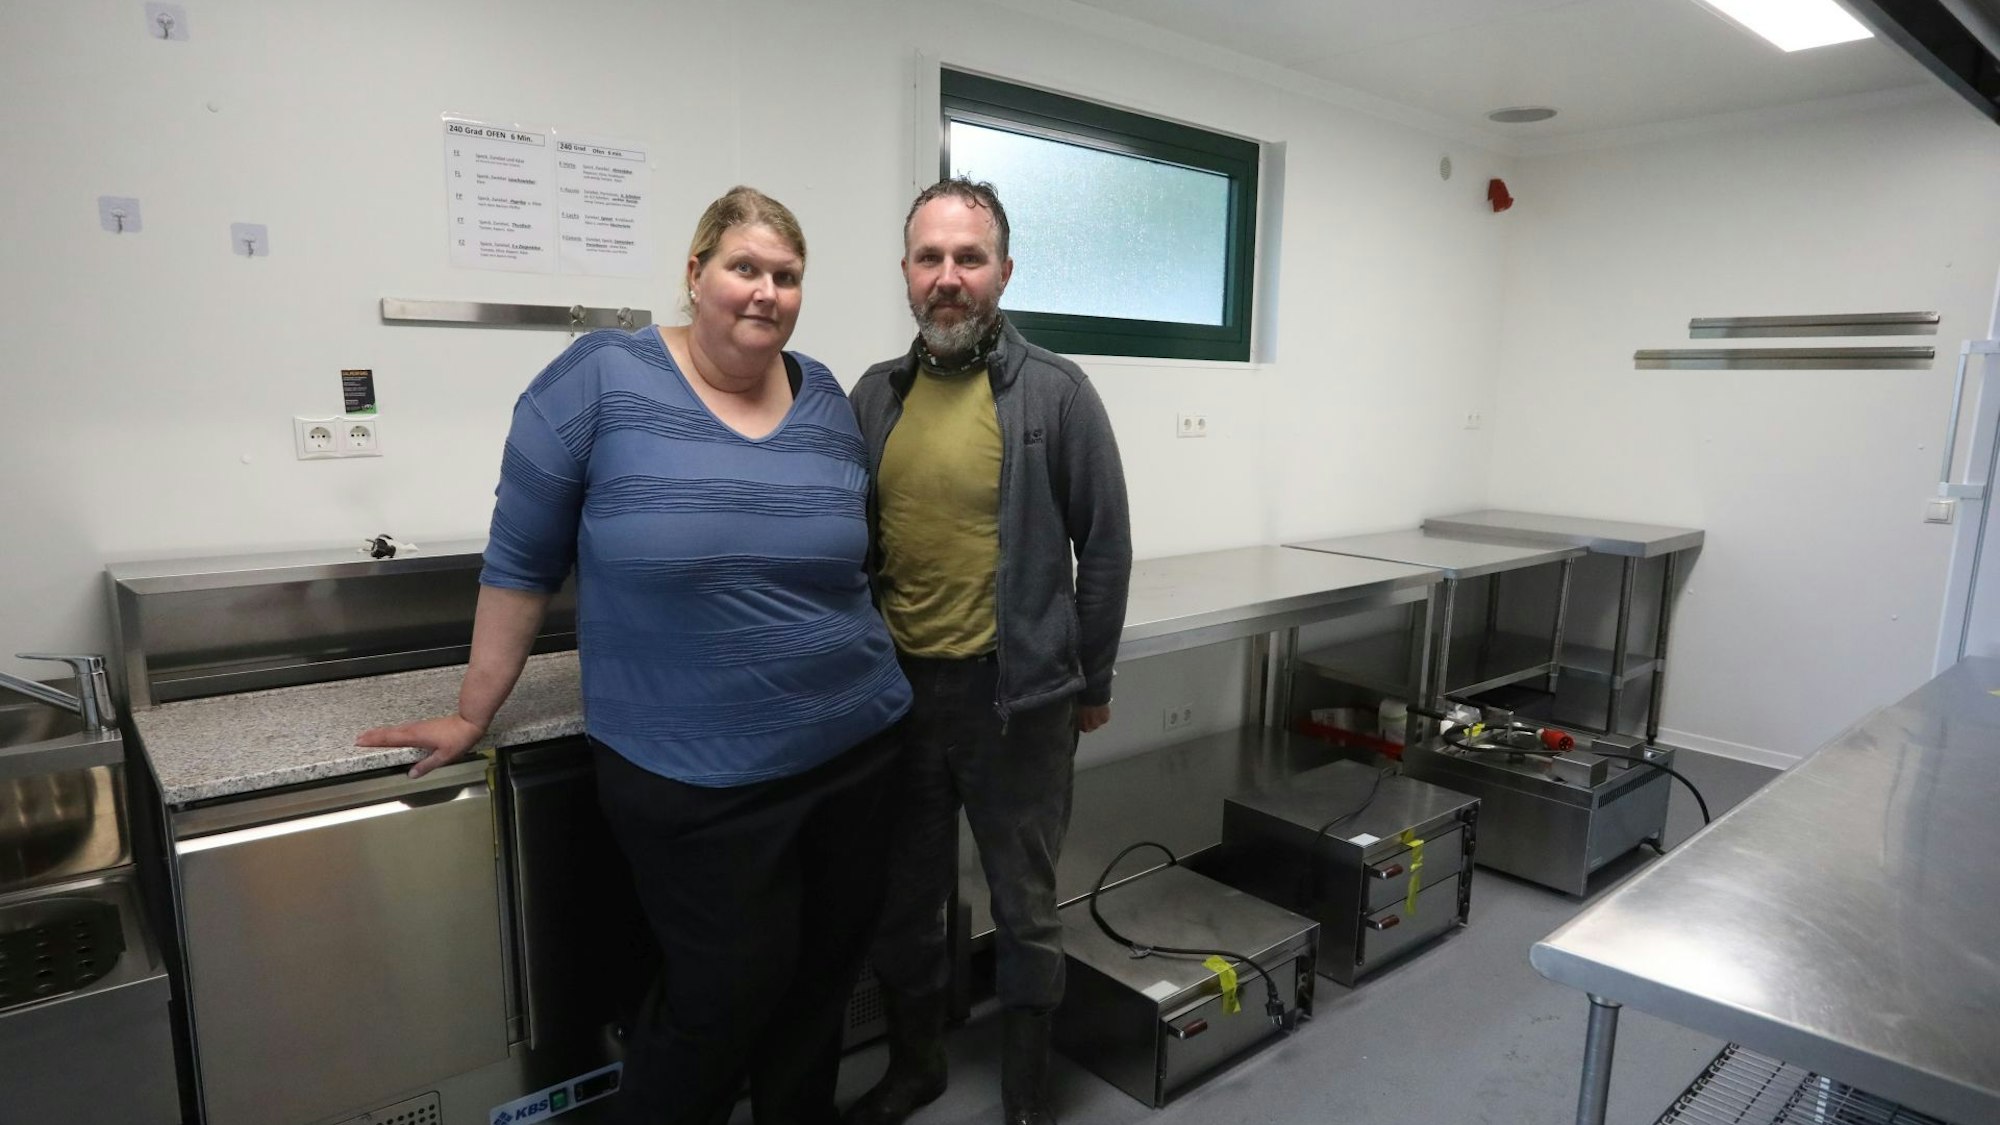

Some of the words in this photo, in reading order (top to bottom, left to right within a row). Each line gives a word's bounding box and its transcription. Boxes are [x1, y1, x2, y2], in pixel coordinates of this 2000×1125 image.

[449, 125, 463, 133] 240
[465, 127, 483, 136] Grad
[486, 130, 506, 139] OFEN
[517, 134, 533, 142] Min.
[559, 142, 573, 151] 240
[515, 1099, 549, 1120] KBS
